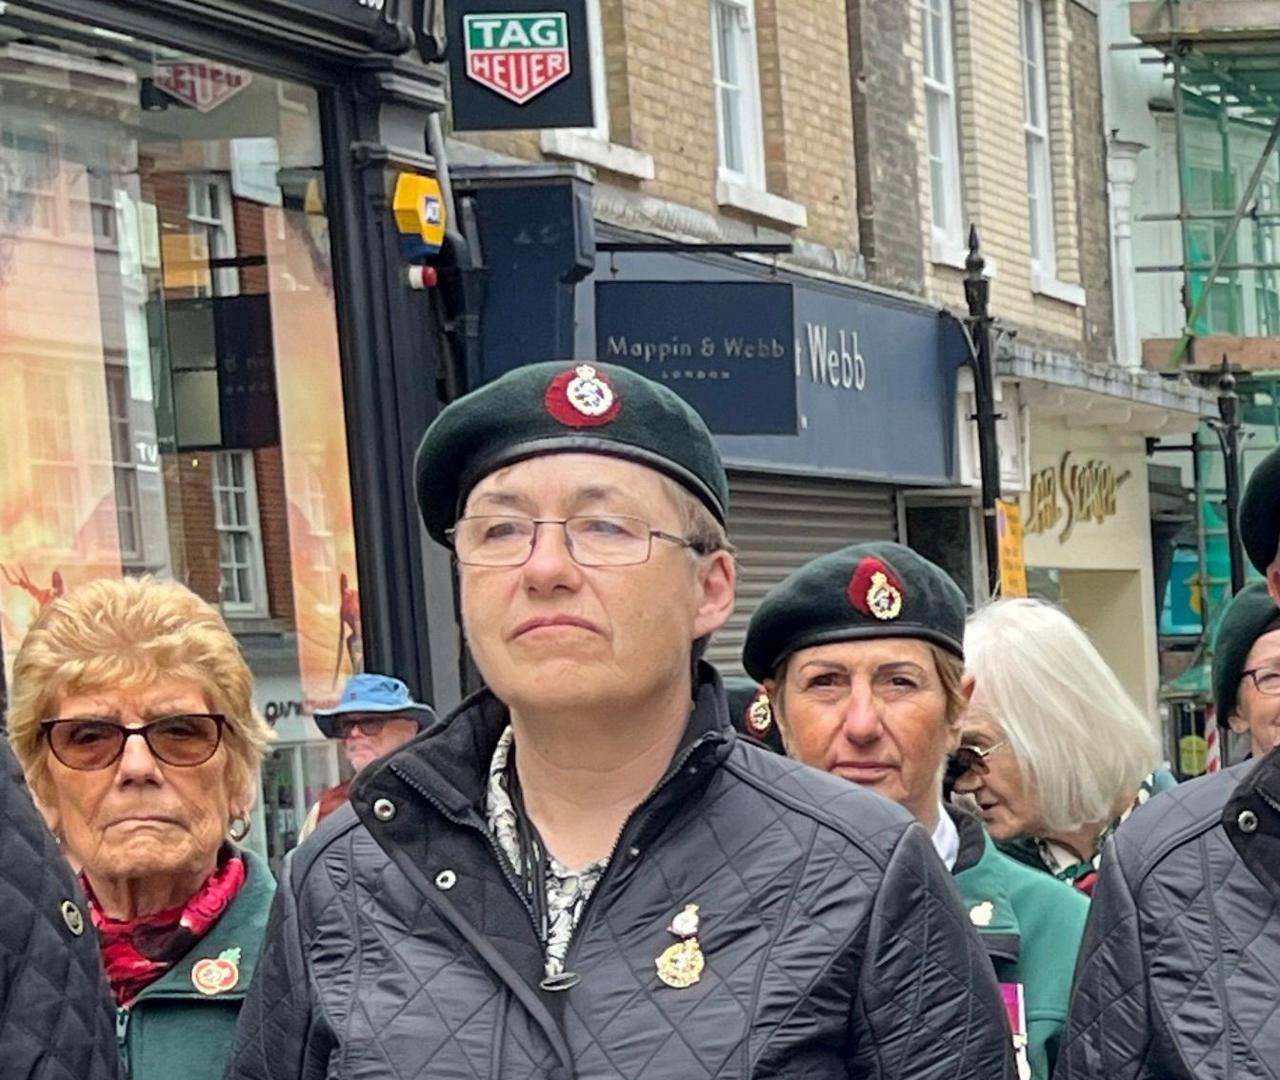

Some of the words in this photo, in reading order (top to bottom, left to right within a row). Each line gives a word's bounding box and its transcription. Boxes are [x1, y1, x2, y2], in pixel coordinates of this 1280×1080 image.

[472, 19, 558, 48] TAG
[473, 53, 562, 96] HEUER
[608, 336, 692, 362] Mappin
[702, 337, 715, 357] &
[724, 338, 785, 359] Webb
[806, 321, 865, 391] Webb
[662, 370, 731, 379] LONDON
